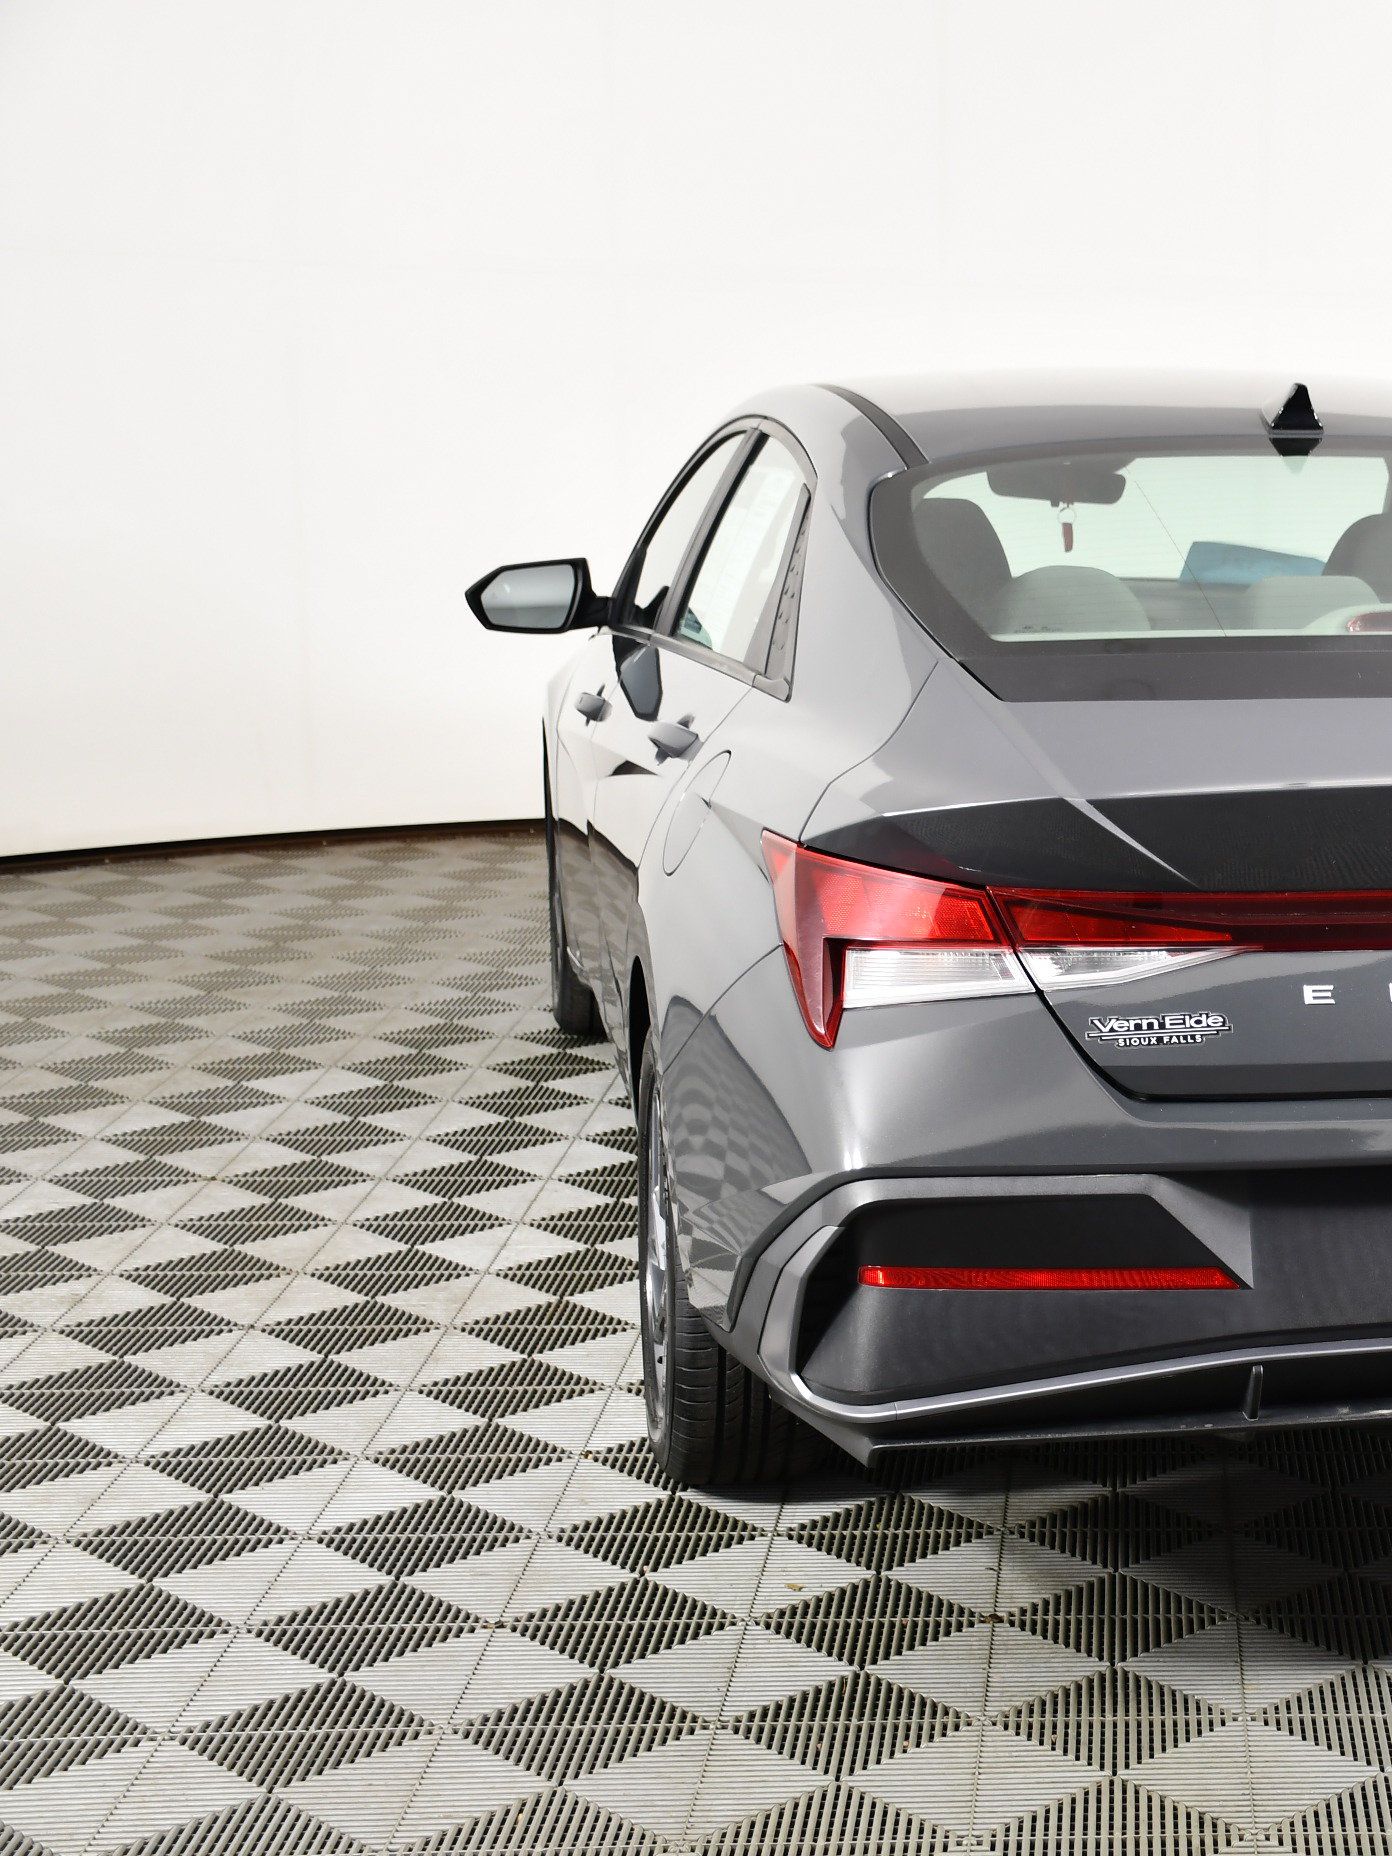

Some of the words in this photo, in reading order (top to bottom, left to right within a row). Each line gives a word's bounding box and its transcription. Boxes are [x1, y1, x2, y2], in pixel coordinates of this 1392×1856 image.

[1093, 1018, 1159, 1033] Vern
[1165, 1013, 1224, 1028] Eide
[1117, 1037, 1158, 1047] SIOUX
[1163, 1034, 1203, 1044] FALLS
